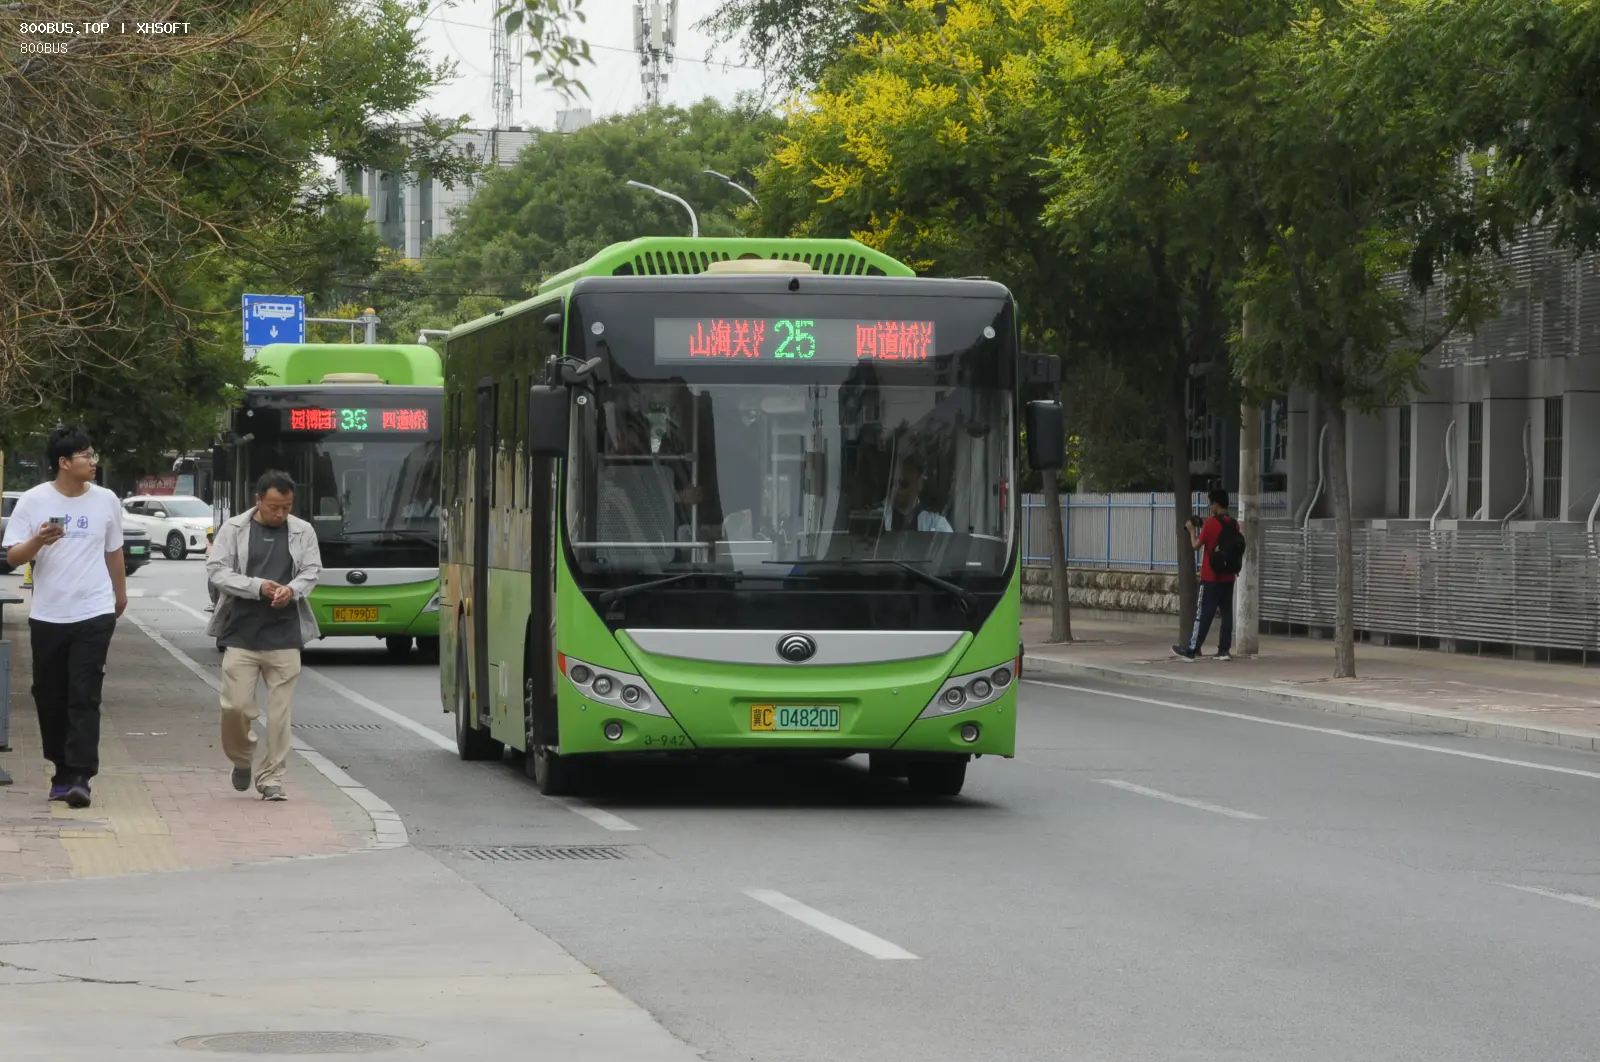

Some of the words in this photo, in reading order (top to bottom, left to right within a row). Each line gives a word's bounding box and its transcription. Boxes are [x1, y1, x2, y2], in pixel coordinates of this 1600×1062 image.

[774, 320, 817, 359] 25
[780, 708, 838, 727] 04820D
[644, 734, 686, 747] 3-942
